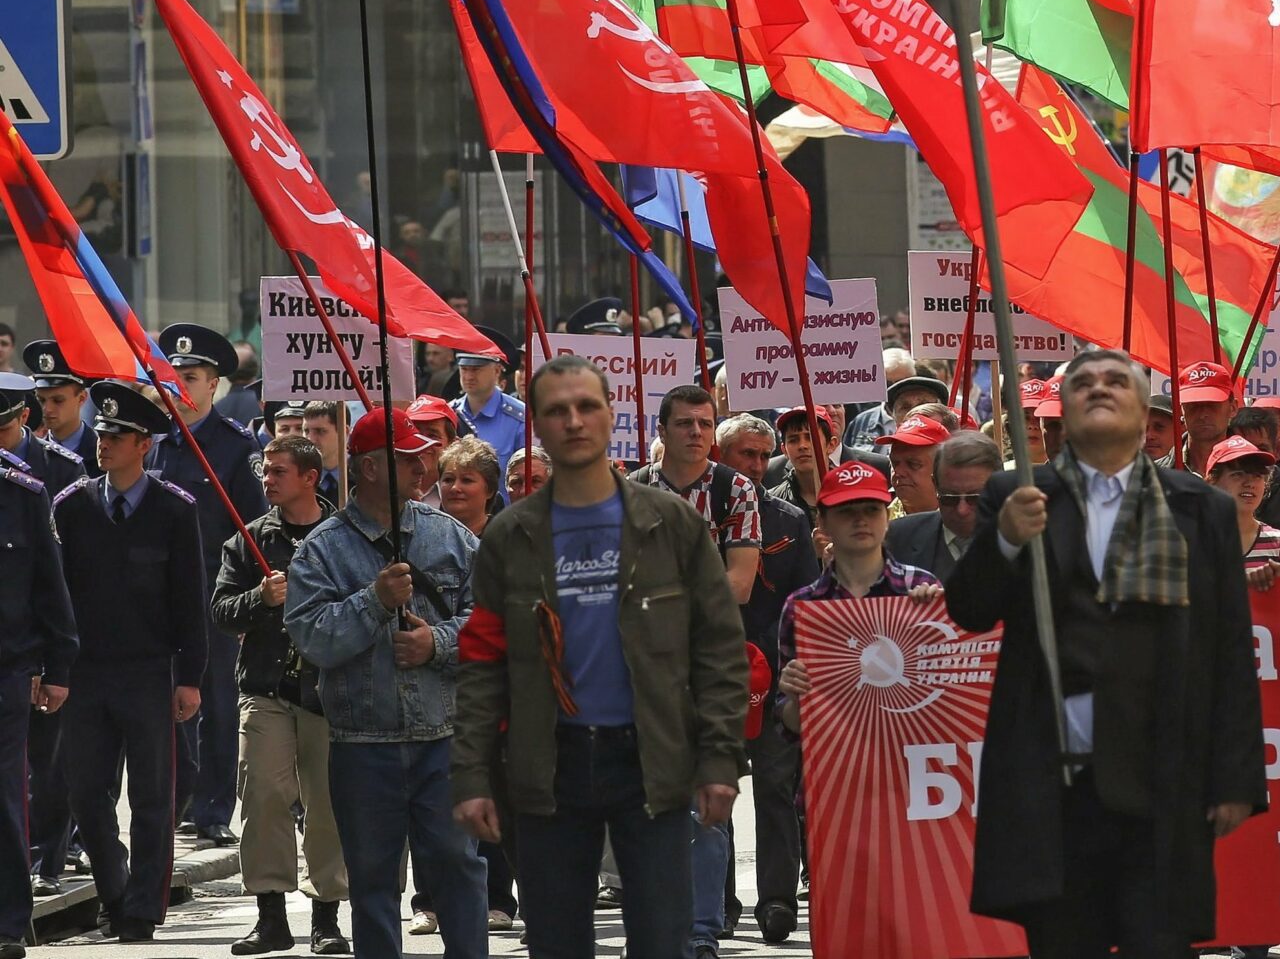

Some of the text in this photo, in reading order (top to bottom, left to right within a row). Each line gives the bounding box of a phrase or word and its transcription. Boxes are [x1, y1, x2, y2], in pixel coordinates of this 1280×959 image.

[557, 348, 677, 376] сский
[1200, 370, 1217, 378] КПУ
[740, 370, 778, 389] КПУ
[814, 364, 877, 385] жизнь!
[852, 469, 874, 478] КПУ
[904, 742, 979, 821] Б
